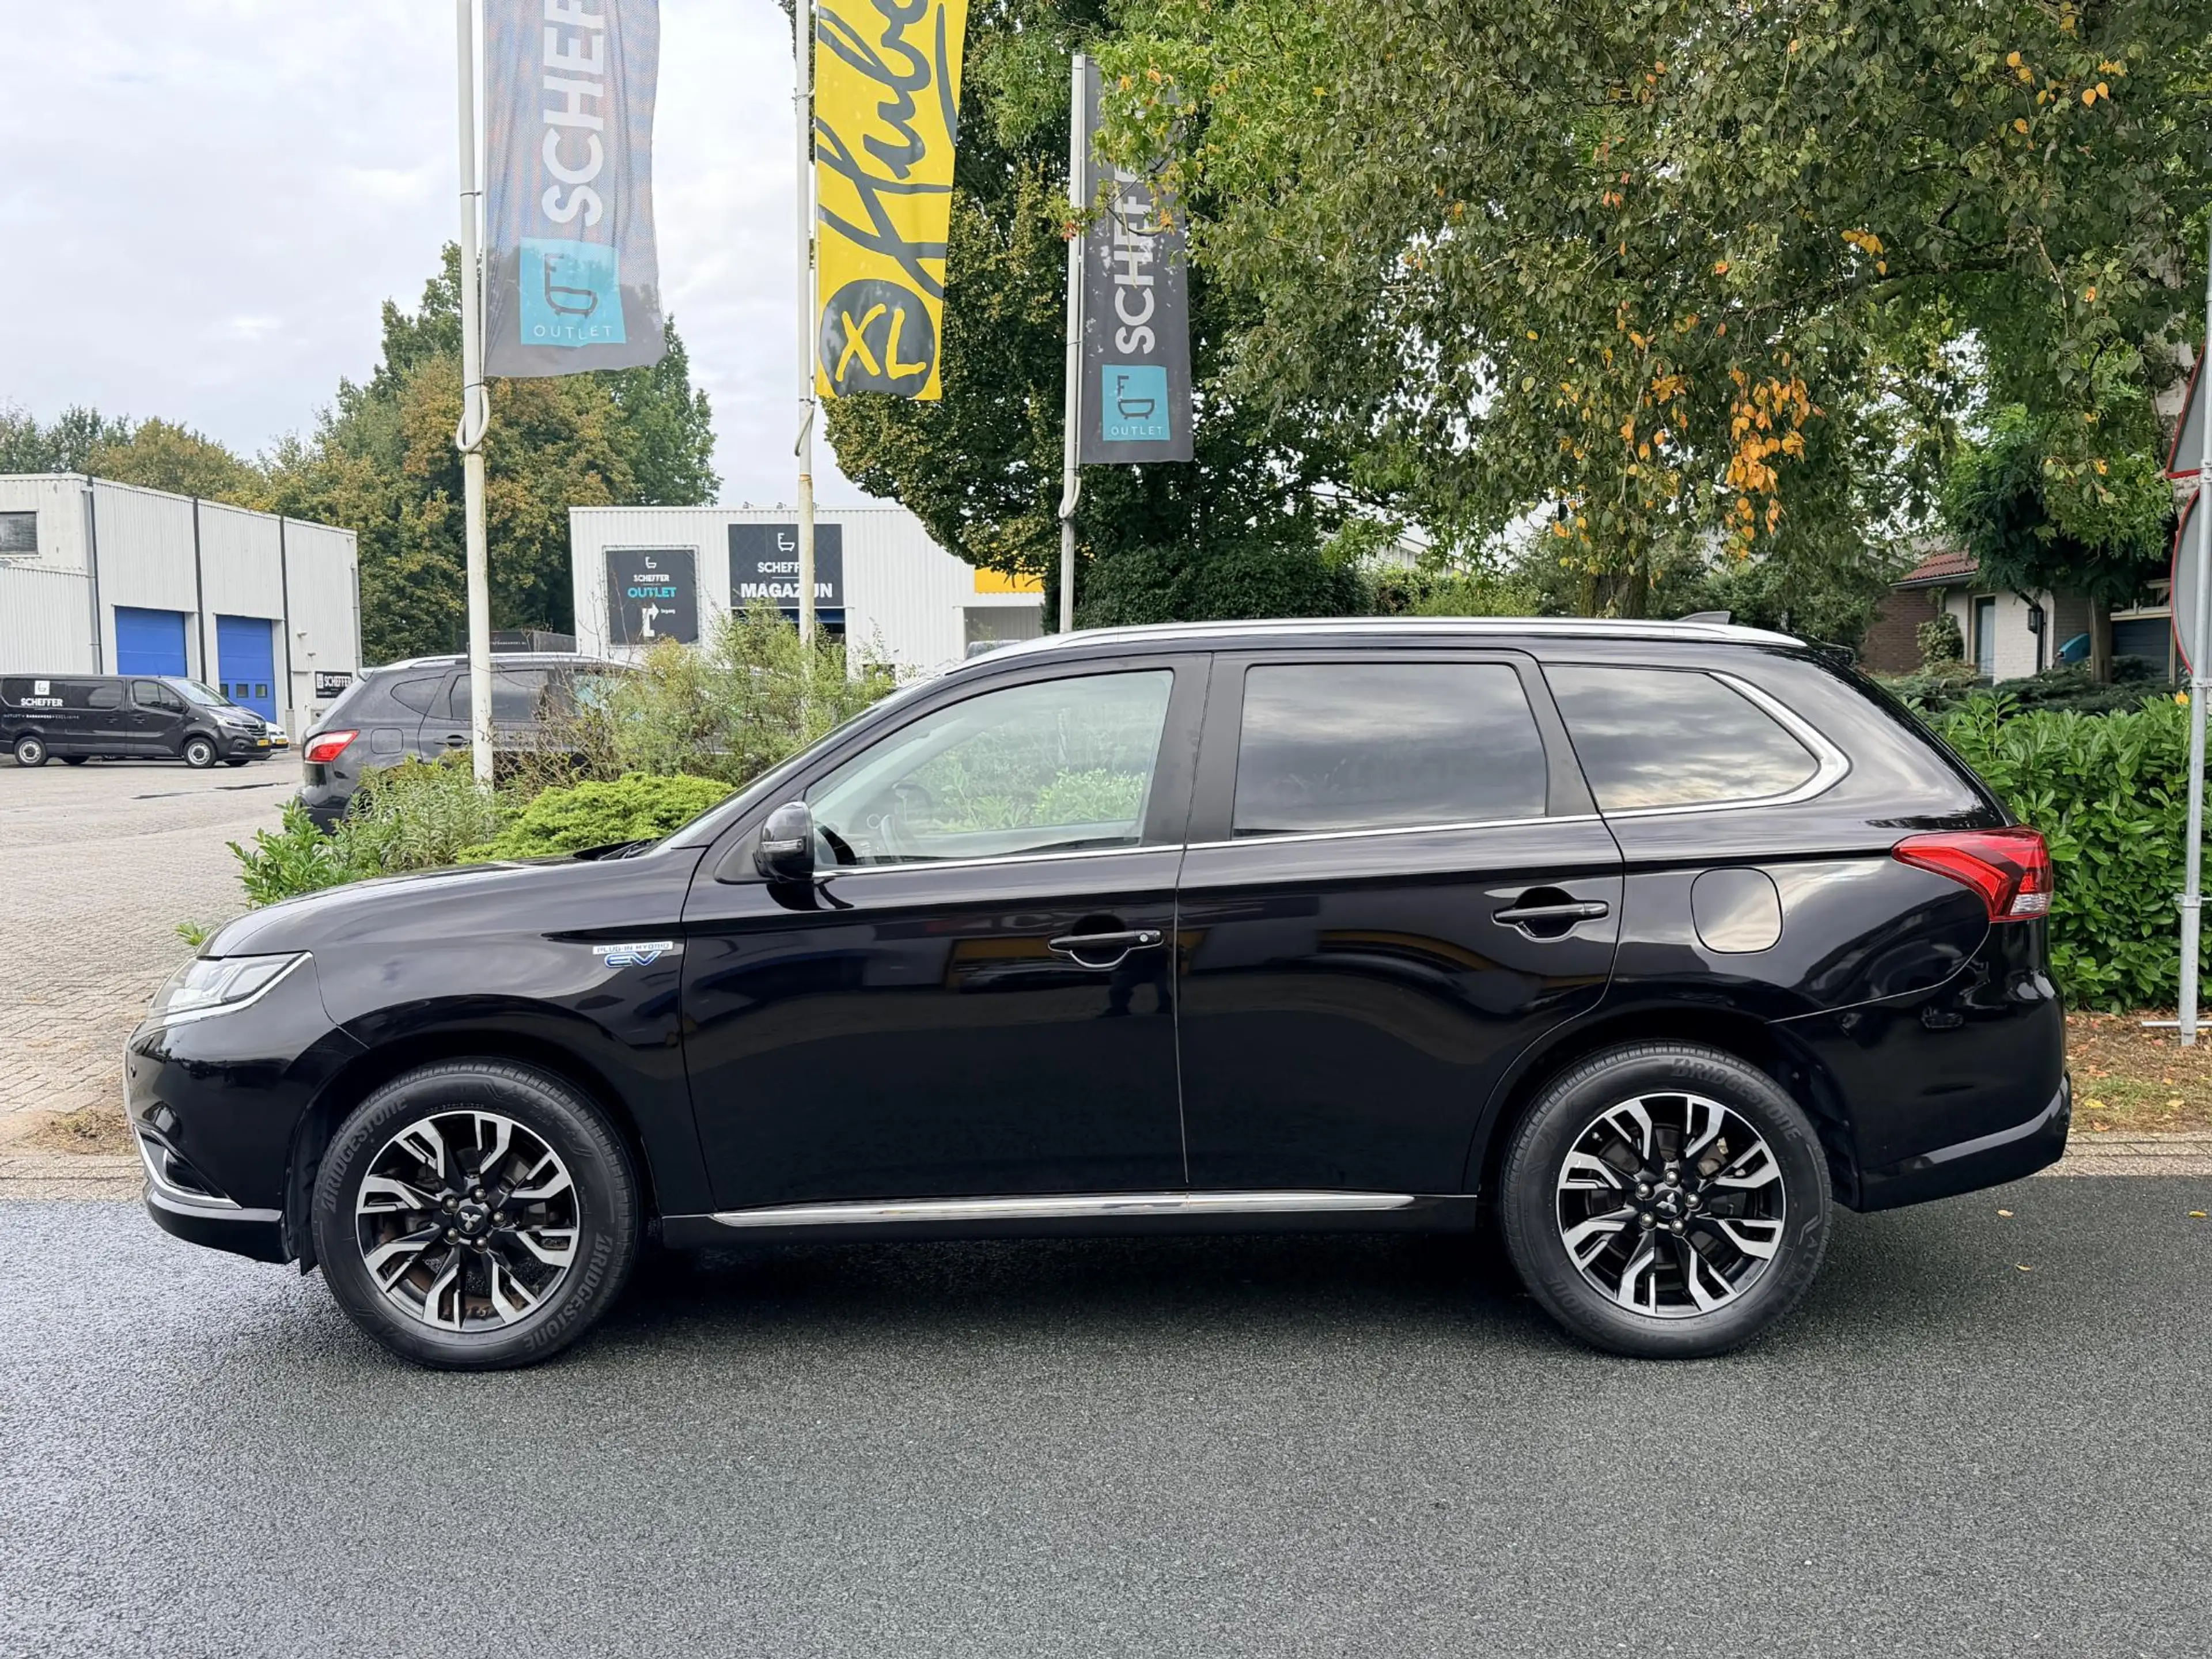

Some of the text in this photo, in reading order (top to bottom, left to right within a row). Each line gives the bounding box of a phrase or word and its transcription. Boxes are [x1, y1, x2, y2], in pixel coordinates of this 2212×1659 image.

[533, 324, 612, 340] OUTLET
[835, 303, 926, 382] XL
[1111, 425, 1164, 436] OUTLET
[633, 574, 670, 582] SCHEFFER
[627, 586, 677, 598] OUTLET
[20, 698, 63, 707] SCHEFFER
[1671, 1058, 1803, 1142] BRIDGESTONE
[321, 1097, 408, 1214] BRIDGESTONE
[522, 1233, 615, 1351] BRIDGESTONE
